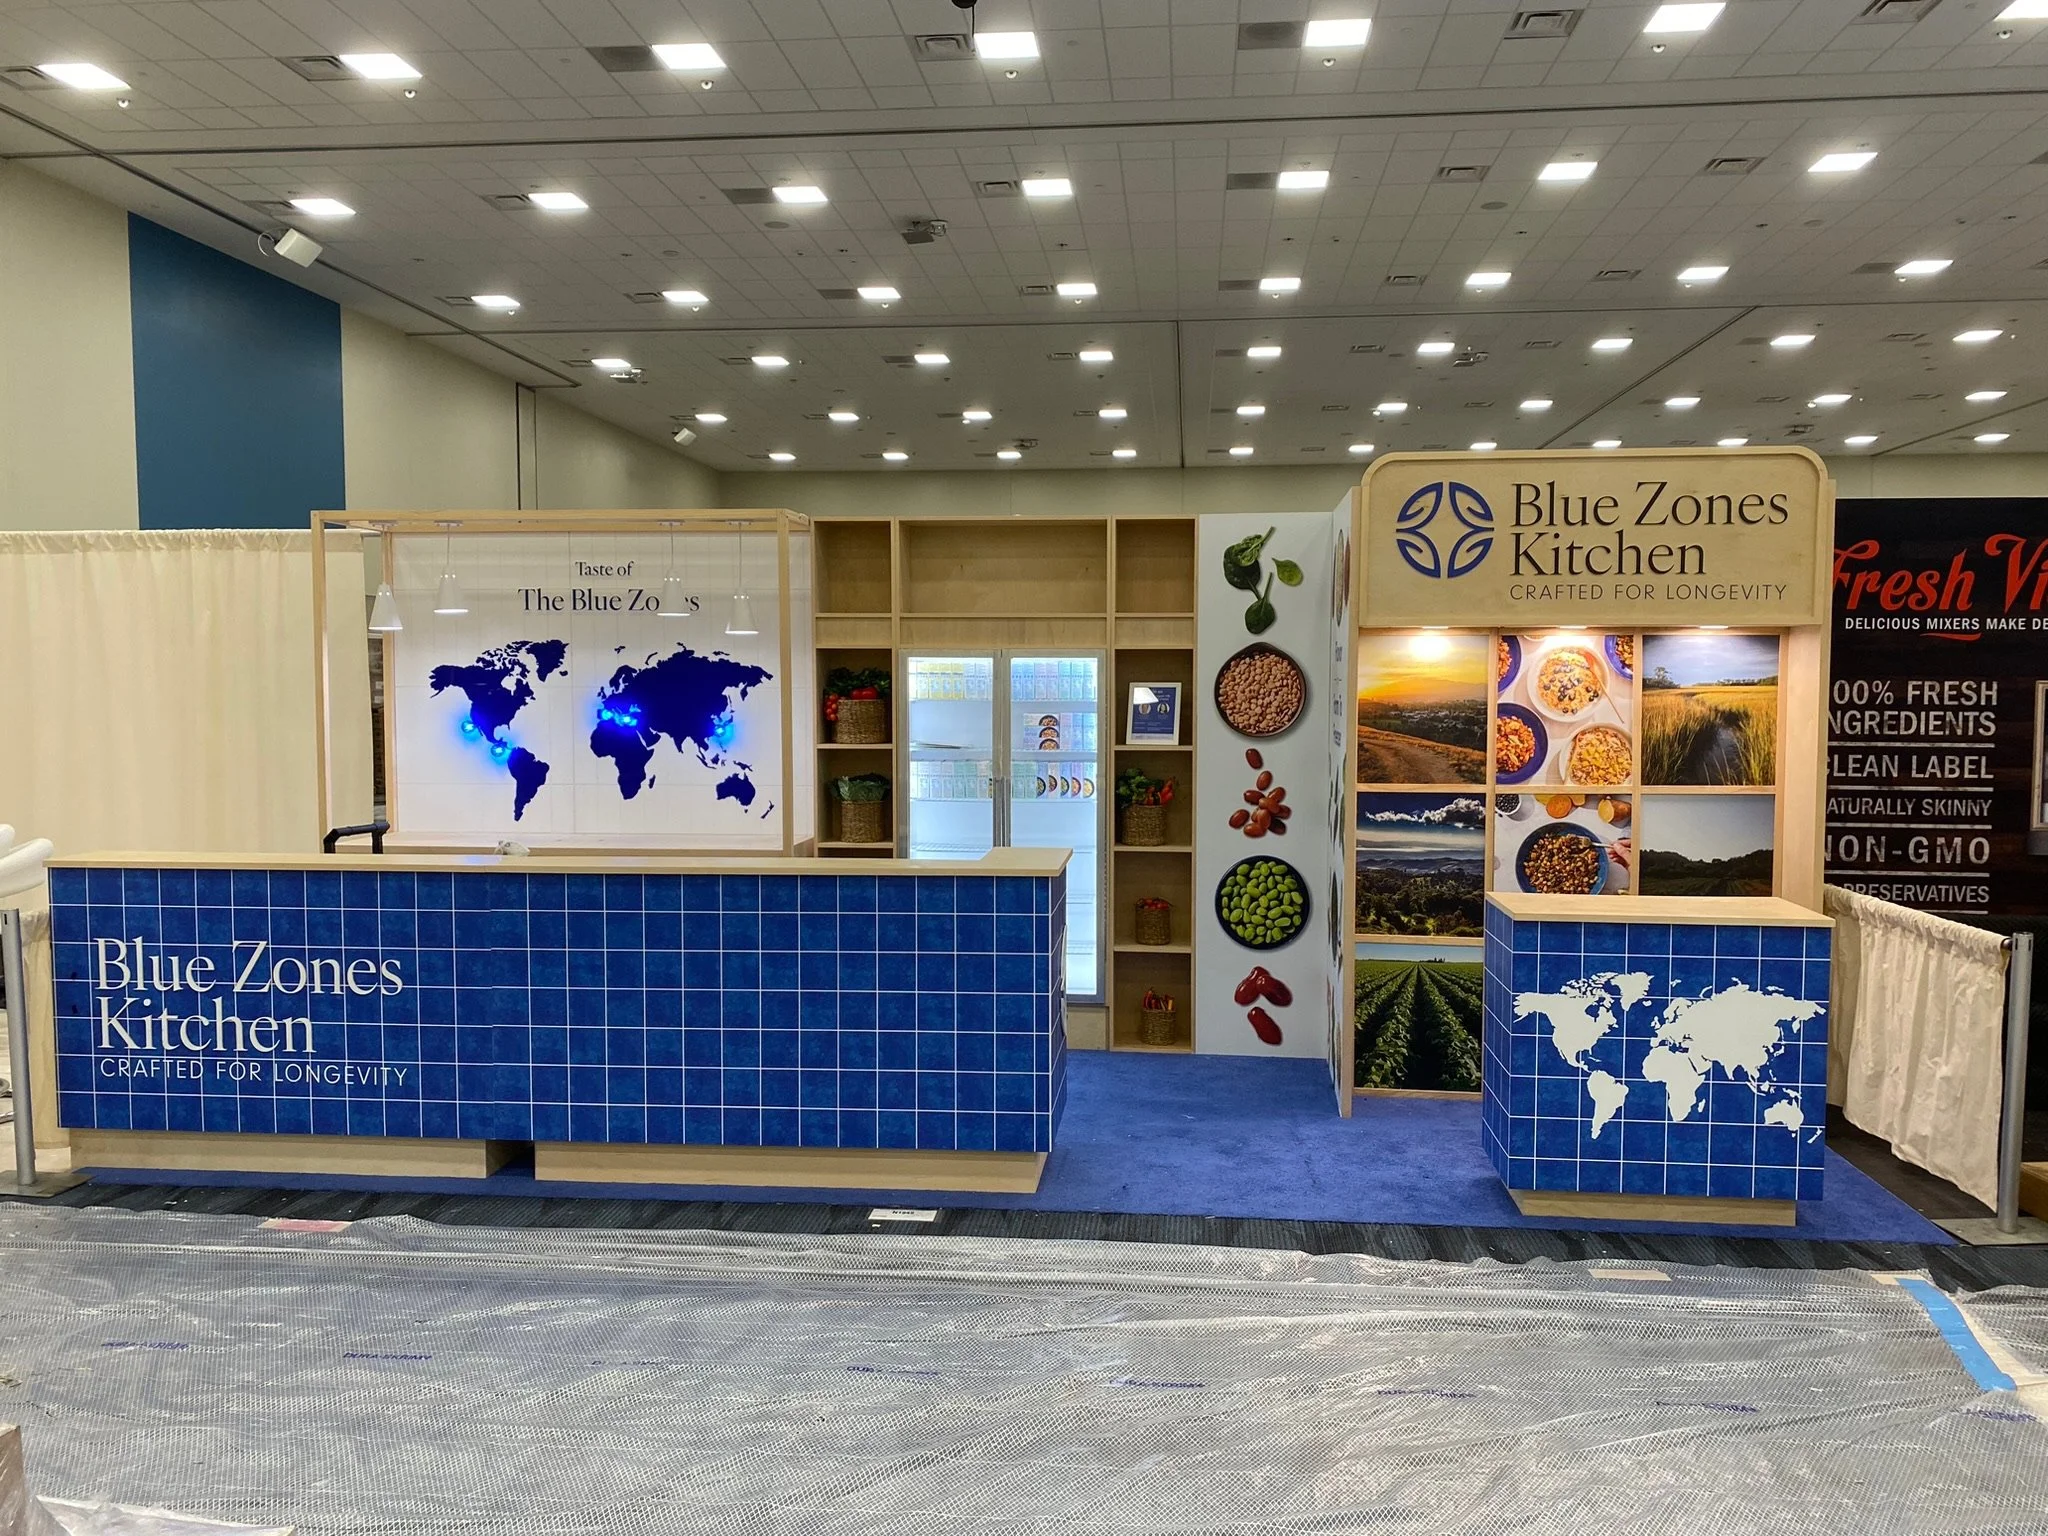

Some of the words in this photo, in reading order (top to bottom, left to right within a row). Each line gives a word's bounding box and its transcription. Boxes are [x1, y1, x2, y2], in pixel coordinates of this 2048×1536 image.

[1511, 480, 1620, 527] Blue
[1634, 481, 1789, 526] Zones
[1510, 529, 1706, 576] Kitchen
[575, 561, 614, 577] Taste
[617, 561, 635, 577] of
[1833, 539, 1976, 611] Fresh
[1984, 533, 2048, 614] Vi
[518, 588, 565, 611] The
[572, 588, 622, 611] Blue
[628, 588, 700, 611] Zos
[1509, 584, 1604, 600] CRAFTED
[1614, 584, 1655, 600] FOR
[1666, 584, 1788, 600] LONGEVITY
[1845, 617, 1921, 630] DELICIOUS
[1926, 618, 1981, 630] MIXERS
[1986, 618, 2027, 630] MAKE
[1832, 680, 1895, 705] 00%
[1907, 681, 1998, 706] FRESH
[1828, 710, 1997, 736] NGREDIENTS
[1826, 754, 1899, 777] LEAN
[1911, 755, 1995, 779] LABEL
[1826, 797, 1917, 816] ATURALLY
[1921, 798, 1993, 816] SKINNY
[93, 936, 217, 992] Blue
[231, 940, 404, 995] Zones
[95, 996, 317, 1053] Kitchen
[100, 1058, 204, 1079] CRAFTED
[216, 1061, 262, 1081] FOR
[274, 1063, 408, 1086] LONGEVITY
